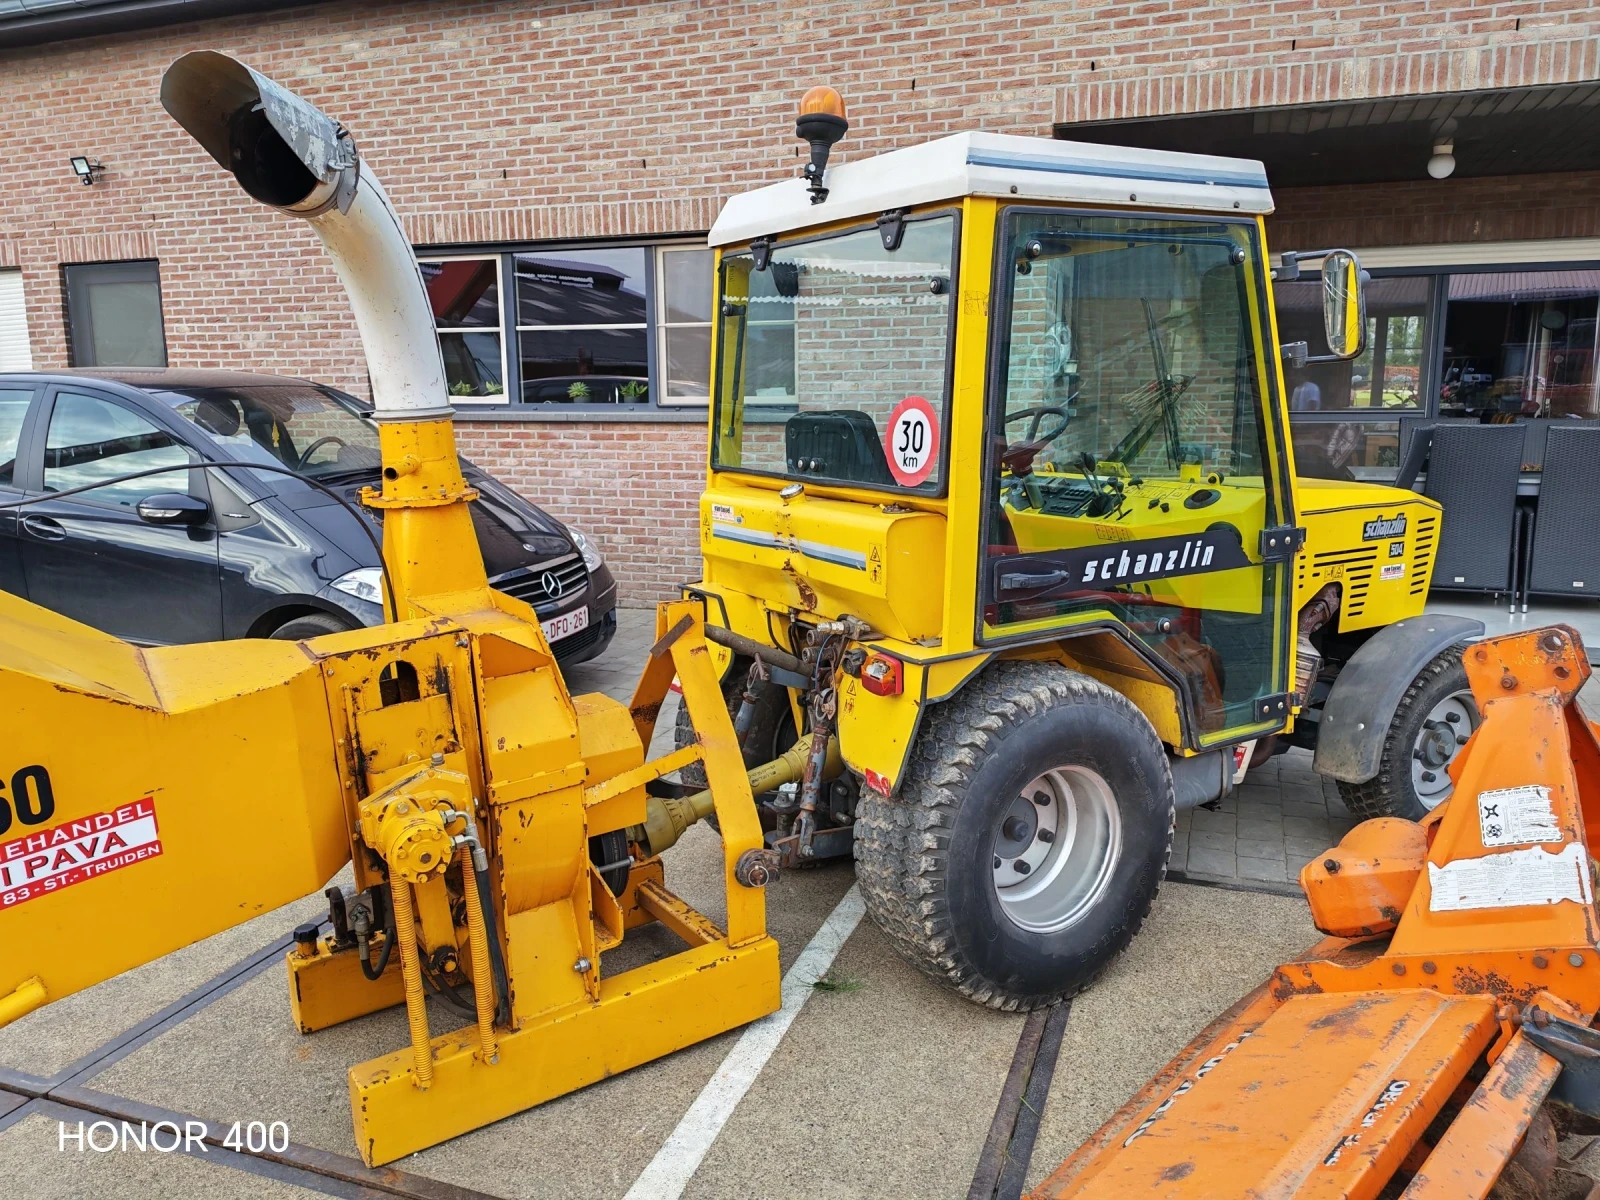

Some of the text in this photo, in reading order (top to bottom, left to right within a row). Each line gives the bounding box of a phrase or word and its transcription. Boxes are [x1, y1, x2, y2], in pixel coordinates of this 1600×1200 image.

[898, 420, 924, 453] 30
[902, 453, 918, 468] km
[1363, 512, 1407, 538] schanzlin
[1081, 540, 1215, 582] schanzlin
[1390, 542, 1403, 556] 504
[0, 803, 153, 861] EHANDEL
[23, 831, 128, 879] PAVA
[82, 844, 160, 877] TRUIDEN
